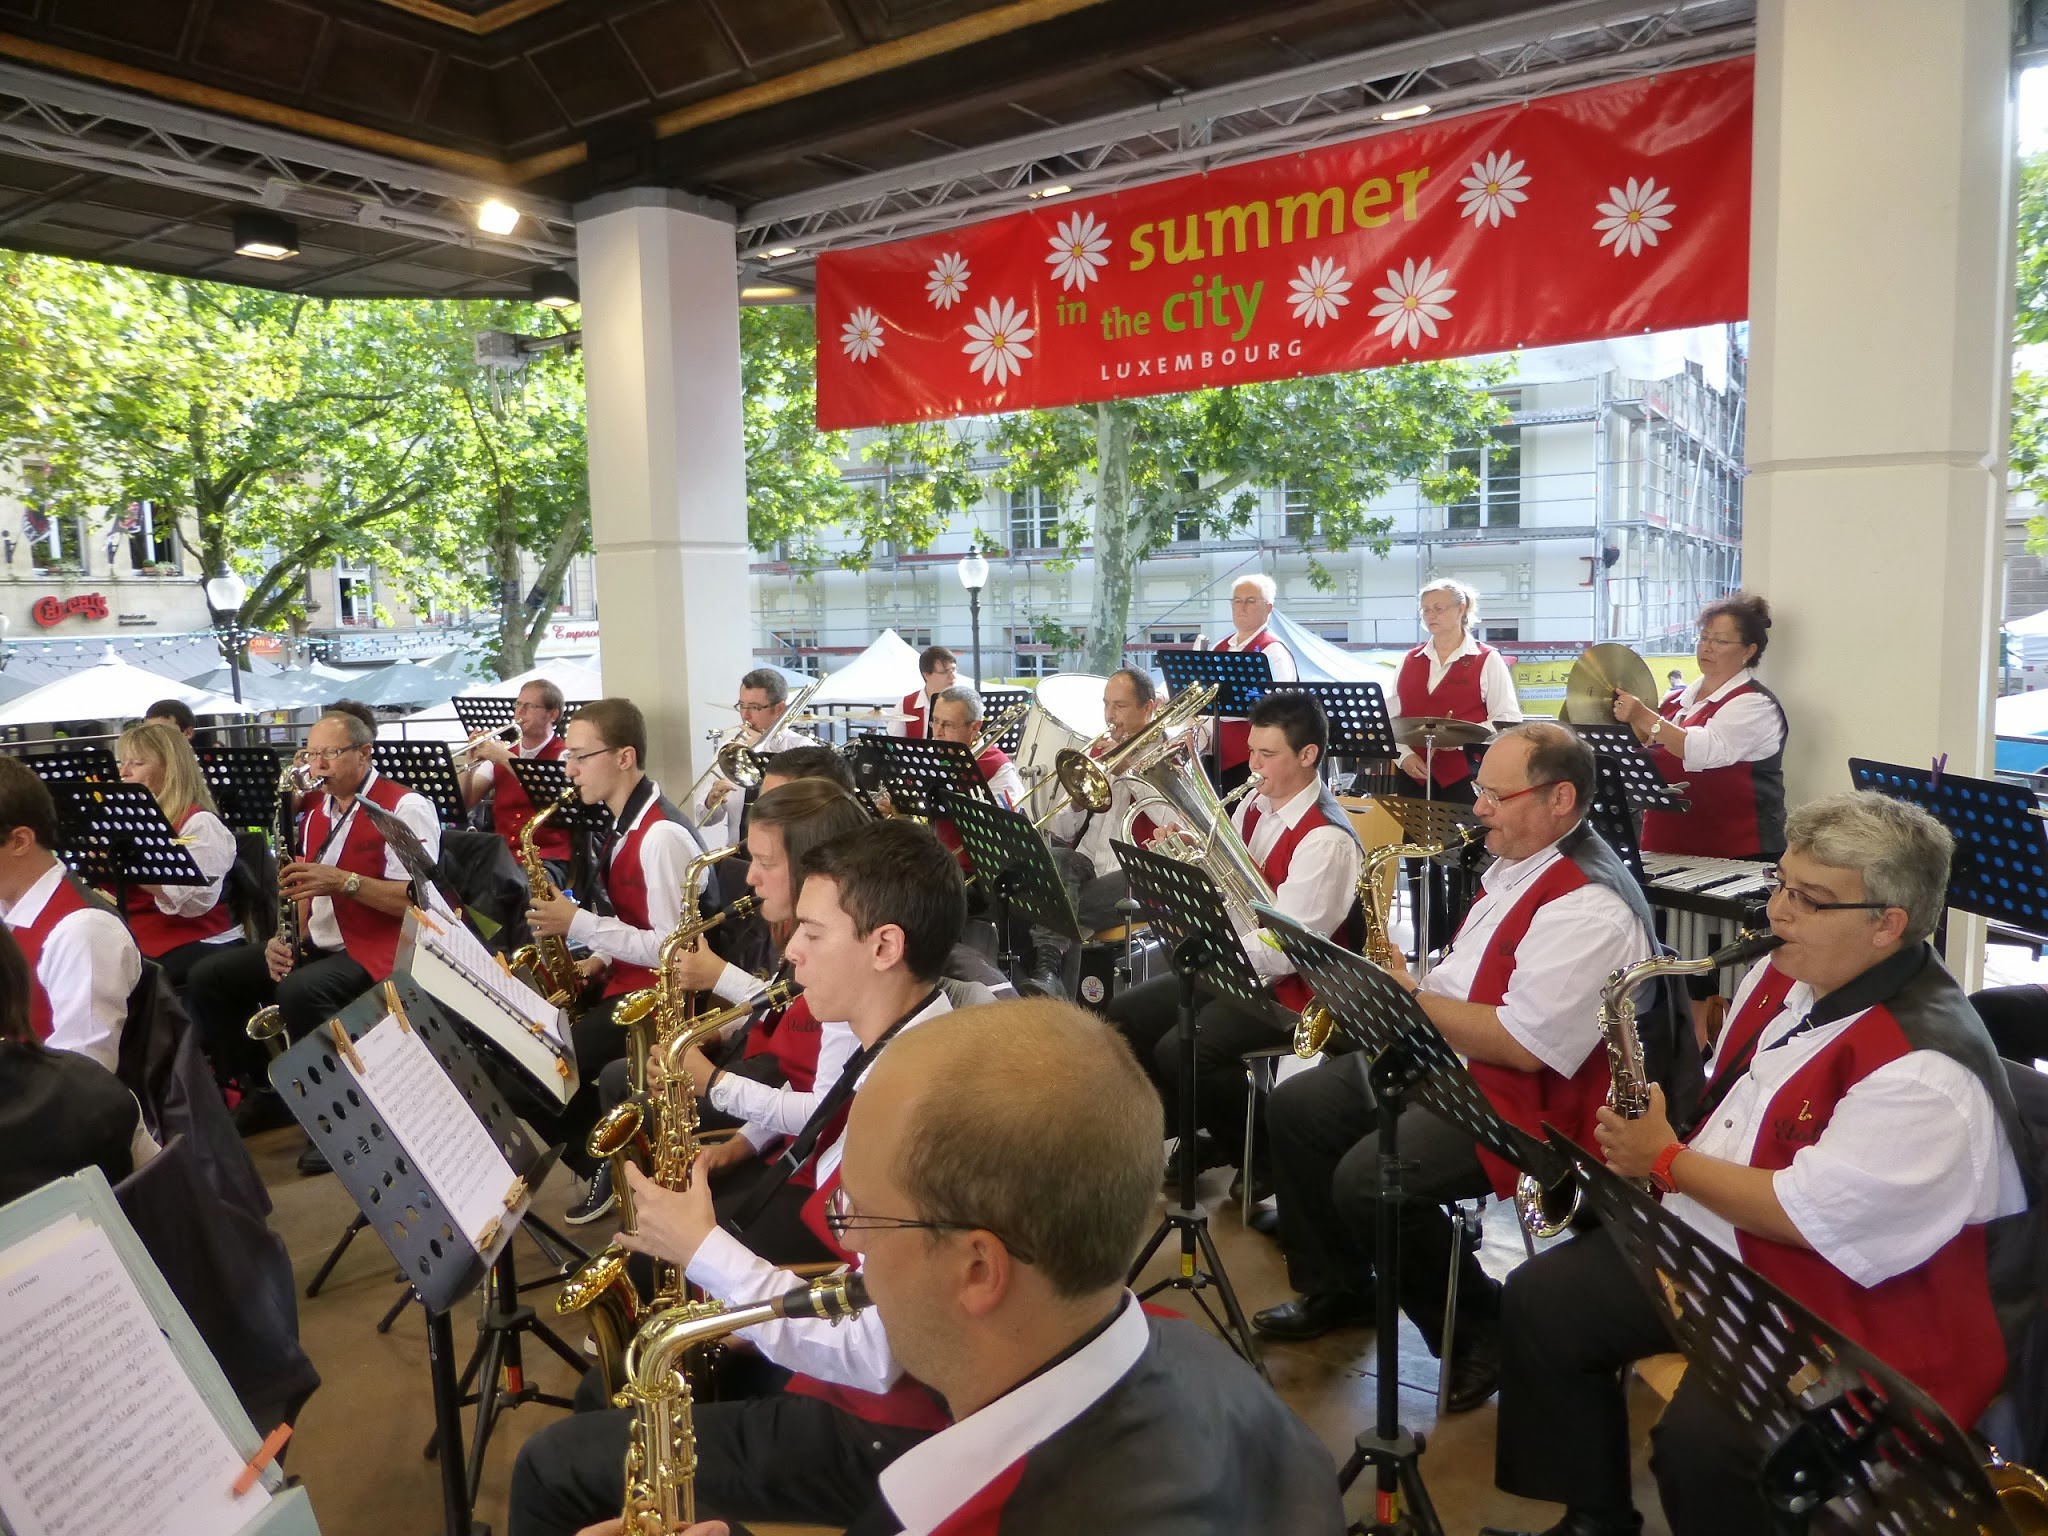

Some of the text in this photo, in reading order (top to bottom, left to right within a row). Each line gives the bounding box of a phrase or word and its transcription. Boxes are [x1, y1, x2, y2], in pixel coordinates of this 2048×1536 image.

[1129, 167, 1430, 271] summer
[1056, 274, 1264, 342] in the city
[1101, 339, 1302, 381] LUXEMBOURG
